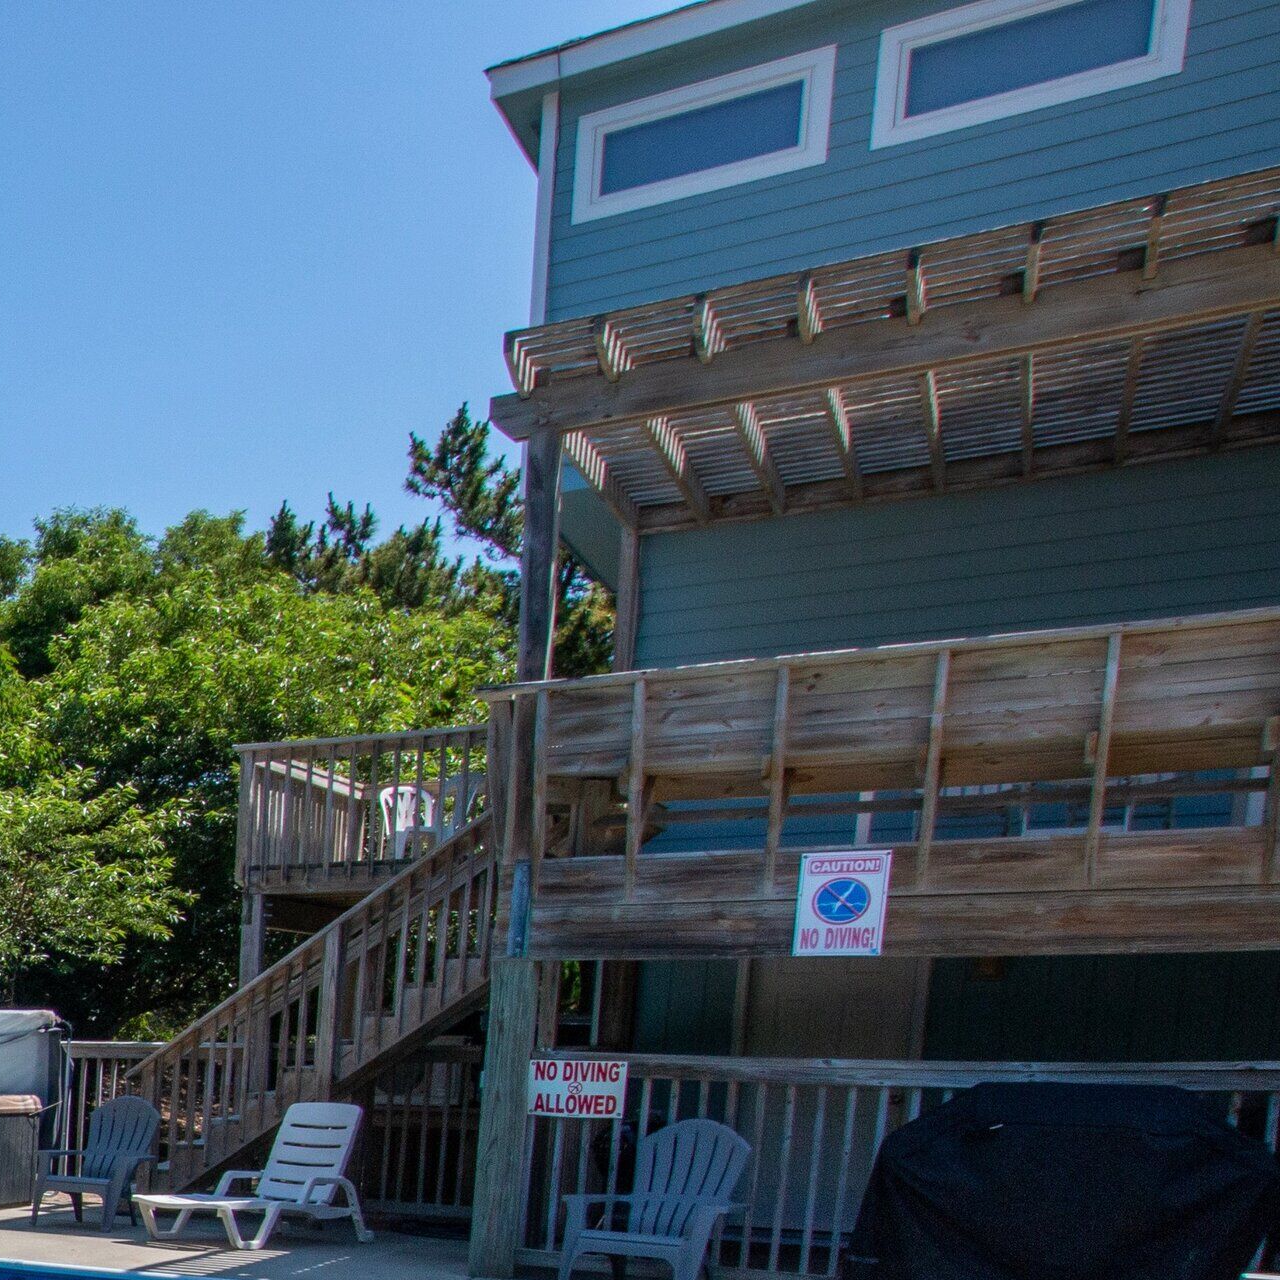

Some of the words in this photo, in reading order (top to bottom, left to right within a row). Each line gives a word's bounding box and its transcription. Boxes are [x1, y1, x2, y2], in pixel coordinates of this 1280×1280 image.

[811, 859, 880, 873] CAUTION!
[800, 929, 819, 949] NO
[824, 927, 876, 950] DIVING!
[534, 1061, 558, 1081] NO
[562, 1061, 620, 1082] DIVING
[534, 1093, 617, 1115] ALLOWED
